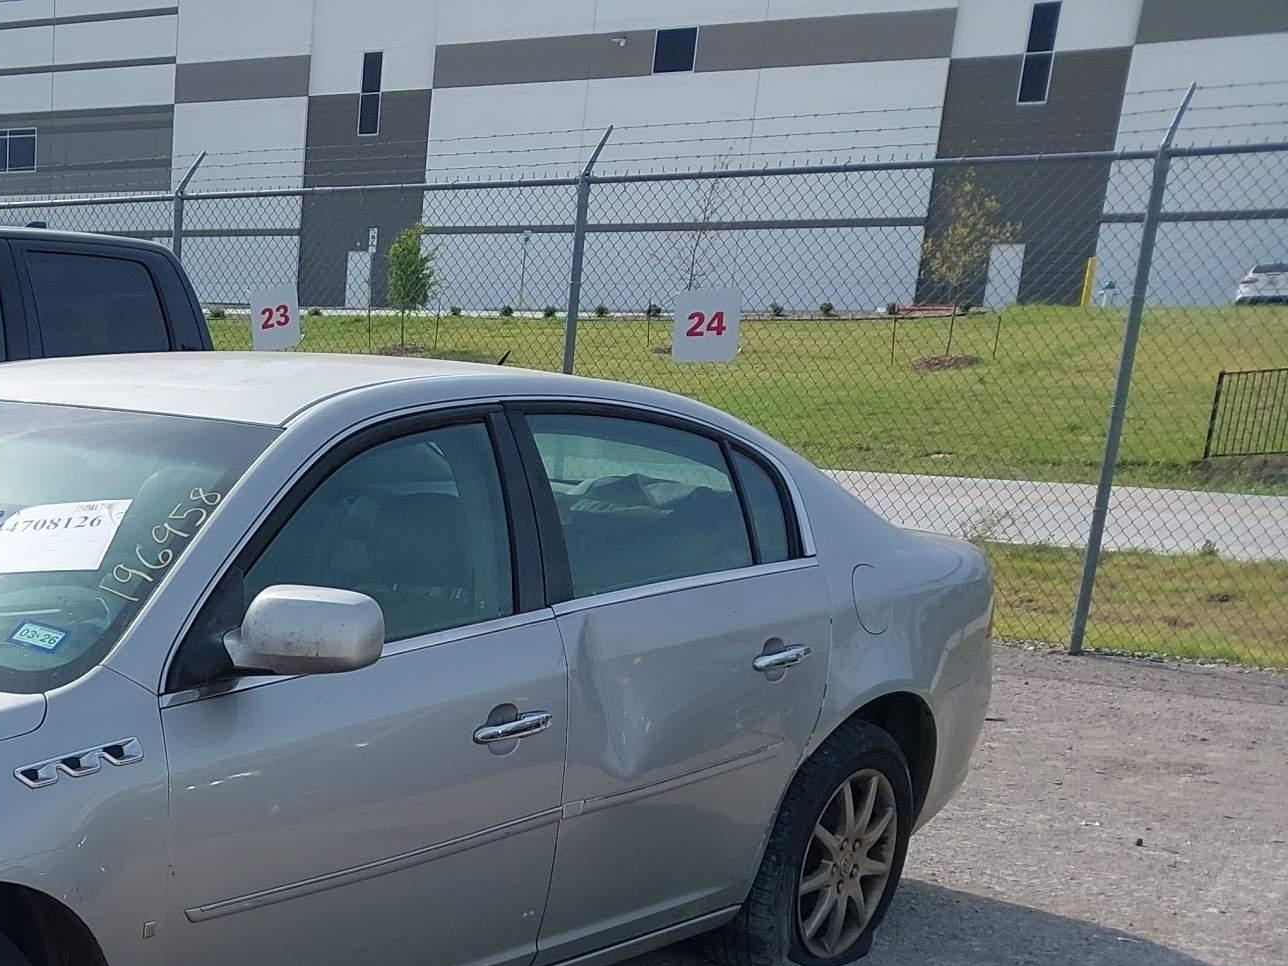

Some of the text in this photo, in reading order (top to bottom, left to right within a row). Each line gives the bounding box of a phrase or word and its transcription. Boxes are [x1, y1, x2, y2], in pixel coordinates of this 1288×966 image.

[261, 304, 290, 330] 23
[686, 311, 727, 337] 24
[98, 487, 222, 602] 196958
